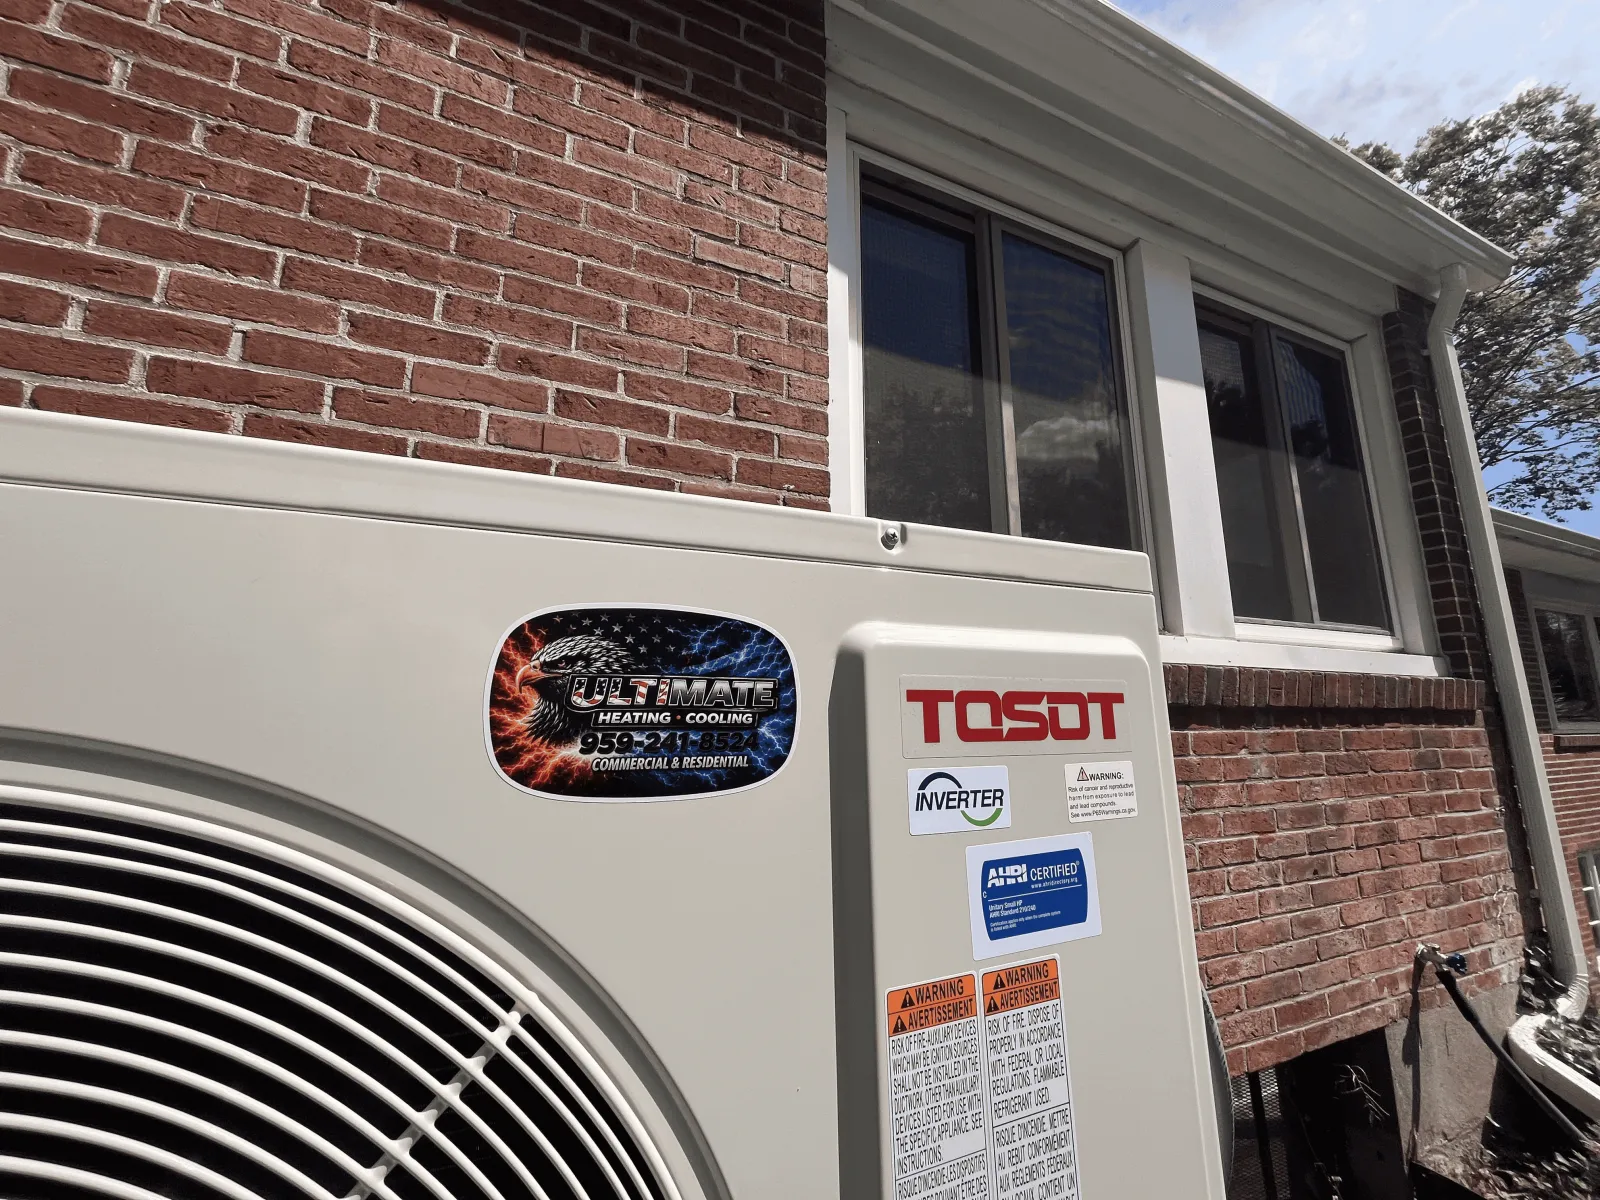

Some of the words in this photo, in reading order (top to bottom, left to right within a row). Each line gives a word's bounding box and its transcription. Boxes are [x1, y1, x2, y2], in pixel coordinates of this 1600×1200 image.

[571, 676, 775, 707] ULTIMATE
[598, 712, 671, 724] HEATING
[685, 712, 753, 724] COOLING
[906, 689, 1124, 743] TOSOT
[579, 731, 758, 755] 959-241-8524
[592, 757, 668, 771] COMMERCIAL
[671, 757, 680, 768] &
[684, 756, 748, 769] RESIDENTIAL
[1089, 772, 1124, 781] WARNING:
[915, 788, 1004, 811] INVERTER
[987, 864, 1027, 888] AHRI
[1031, 877, 1078, 889] www.ahridirectory.org
[988, 903, 1004, 912] Unitary
[1004, 901, 1016, 909] Small
[1001, 907, 1018, 916] Standard
[1005, 963, 1048, 986] WARNING
[915, 979, 963, 1005] WARNING
[1000, 981, 1057, 1009] AVERTISSEMENT
[908, 998, 973, 1030] AVERTISSEMENT
[988, 1017, 1000, 1036] RISK
[1003, 1015, 1010, 1032] OF
[1013, 1012, 1026, 1030] FIRE.
[1027, 1005, 1050, 1026] DISPOSE
[1052, 1003, 1059, 1019] OF
[892, 1037, 905, 1056] RISK
[906, 1035, 912, 1053] OF
[955, 1019, 976, 1040] DEVICES
[989, 1034, 1017, 1057] PROPERLY
[1019, 1032, 1025, 1048] IN
[1026, 1022, 1061, 1047] ACCORDANCE
[892, 1053, 910, 1075] WHICH
[911, 1052, 922, 1070] MAY
[923, 1050, 930, 1067] BE
[931, 1043, 953, 1065] IGNITION
[954, 1037, 978, 1059] SOURCES
[991, 1058, 1005, 1077] WITH
[1008, 1051, 1033, 1073] FEDERAL
[1035, 1047, 1043, 1064] OR
[1045, 1041, 1063, 1061] LOCAL
[893, 1075, 911, 1095] SHALL
[912, 1070, 923, 1089] NOT
[924, 1068, 932, 1086] BE
[933, 1060, 961, 1082] INSTALLED
[962, 1058, 967, 1075] IN
[968, 1056, 978, 1074] THE
[926, 1085, 942, 1105] OTHER
[942, 1079, 956, 1100] THAN
[956, 1075, 979, 1096] AUXILIARY
[992, 1069, 1032, 1097] REGULATIONS.
[1034, 1060, 1065, 1084] FLAMMABLE
[896, 1111, 921, 1136] DEVICES
[922, 1105, 941, 1127] LISTED
[943, 1101, 954, 1120] FOR
[955, 1096, 967, 1116] USE
[967, 1092, 981, 1112] WITH
[994, 1091, 1032, 1120] REFRIGERANT
[896, 1134, 908, 1155] THE
[909, 1125, 936, 1151] SPECIFIC
[971, 1111, 983, 1130] SEE
[996, 1125, 1016, 1149] RISQUE
[1049, 1108, 1069, 1130] METTRE
[897, 1144, 943, 1176] INSTRUCTIONS.
[998, 1151, 1005, 1171] AU
[1008, 1145, 1025, 1167] REBUT
[898, 1177, 917, 1200] RISQUE
[957, 1153, 986, 1179] DISPOSITIFS
[976, 1175, 987, 1195] DES
[1000, 1173, 1010, 1194] AUX
[1038, 1175, 1064, 1200] CONTIENT
[1067, 1171, 1075, 1190] UN
